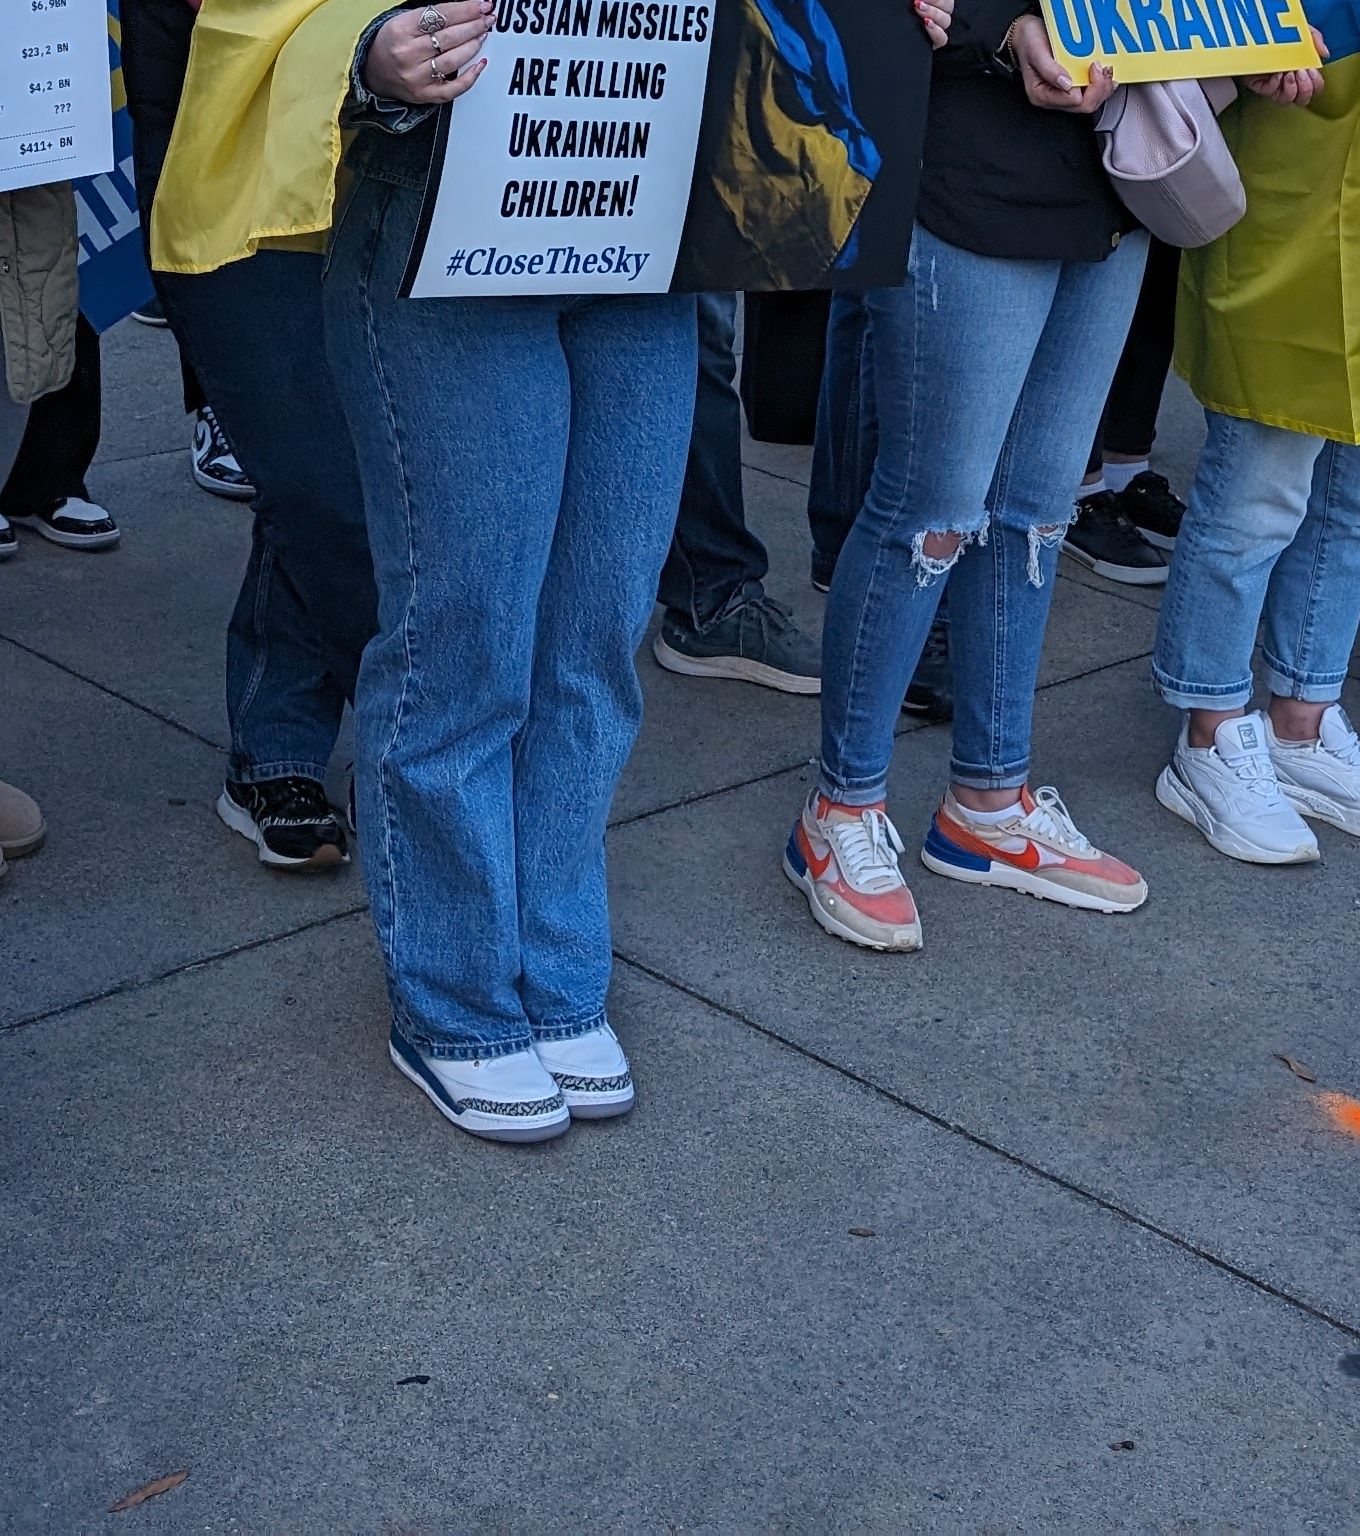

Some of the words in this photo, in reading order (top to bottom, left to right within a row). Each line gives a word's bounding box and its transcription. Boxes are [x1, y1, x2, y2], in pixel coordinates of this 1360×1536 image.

[597, 1, 709, 42] MISSILES
[22, 45, 52, 59] $23,2
[57, 42, 69, 54] BN
[29, 81, 53, 94] $4,2
[59, 78, 70, 89] BN
[508, 57, 557, 96] ARE
[565, 59, 667, 100] KILLING
[54, 102, 71, 114] ???
[20, 141, 53, 155] $411+
[60, 136, 73, 147] BN
[508, 112, 650, 158] UKRAINIAN
[500, 175, 639, 217] CHILDREN!
[446, 246, 649, 281] #CloseTheSky
